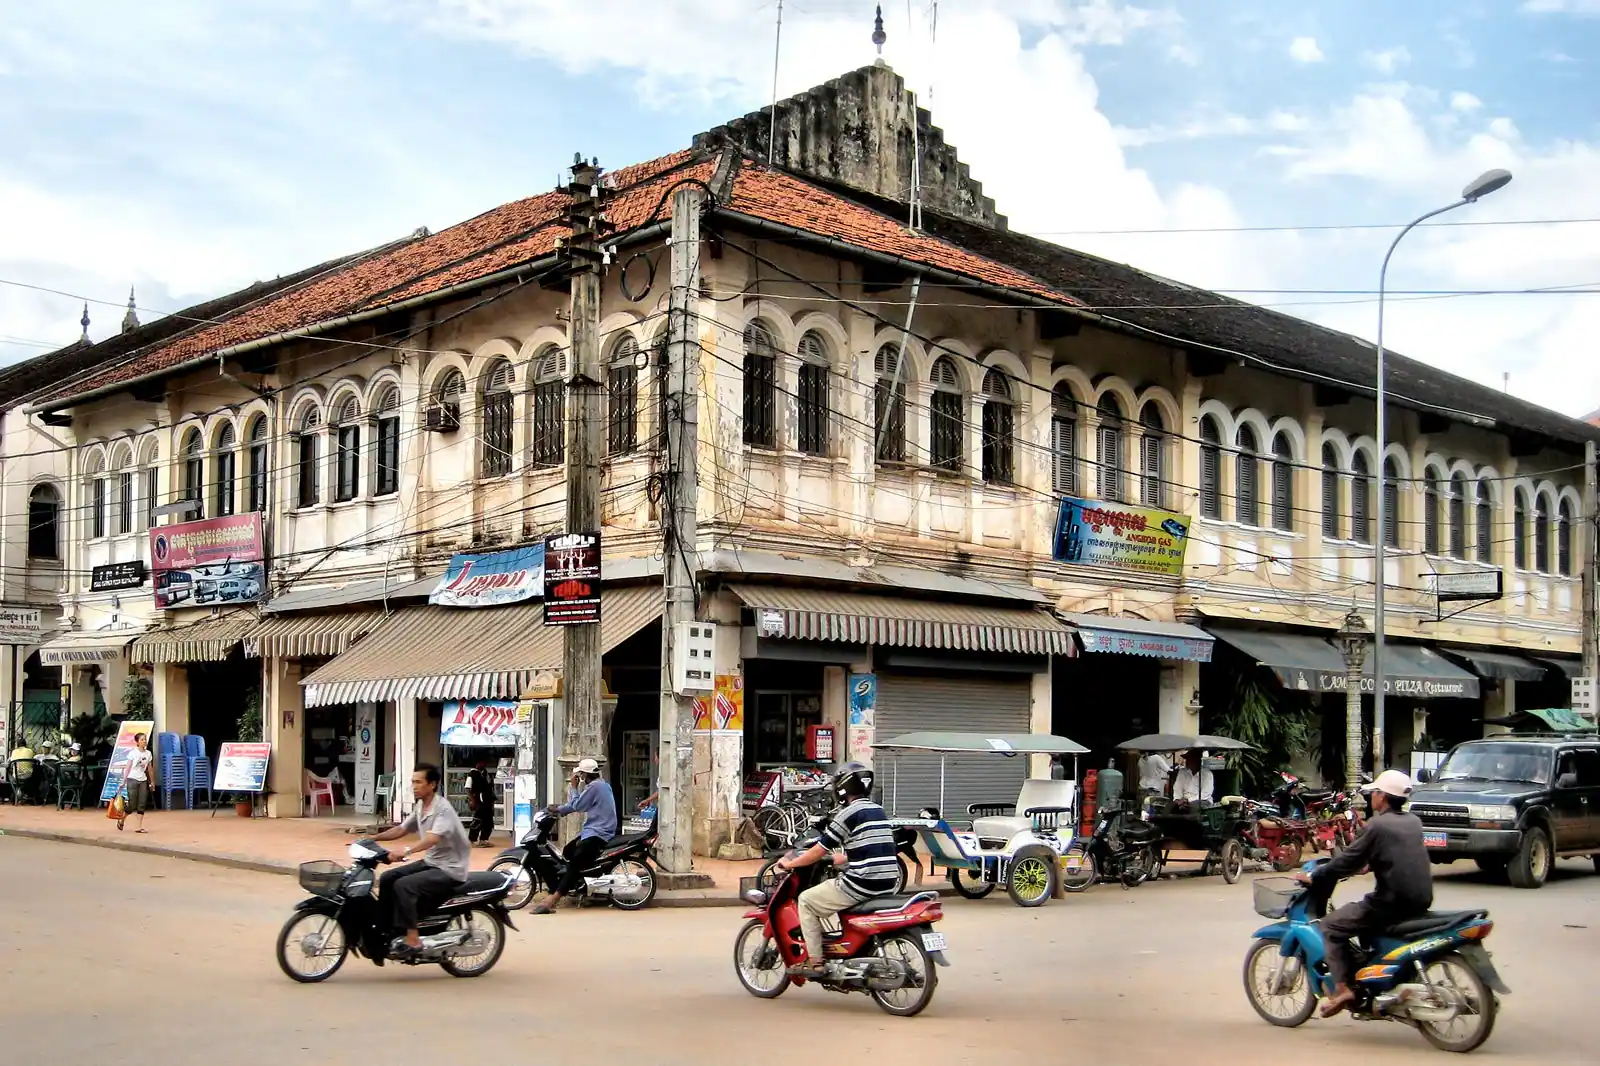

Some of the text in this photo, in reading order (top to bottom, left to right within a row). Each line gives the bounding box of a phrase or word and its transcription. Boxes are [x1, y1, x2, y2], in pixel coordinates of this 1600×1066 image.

[549, 533, 595, 548] TEMPLE
[1125, 533, 1172, 547] ANGKOR GAS
[553, 579, 592, 598] TEMPLE
[1139, 642, 1164, 652] ANGKOR
[1164, 644, 1178, 653] GAS
[46, 652, 60, 662] COOL
[1395, 679, 1423, 694] PIZZA
[1424, 680, 1464, 695] Restaurant
